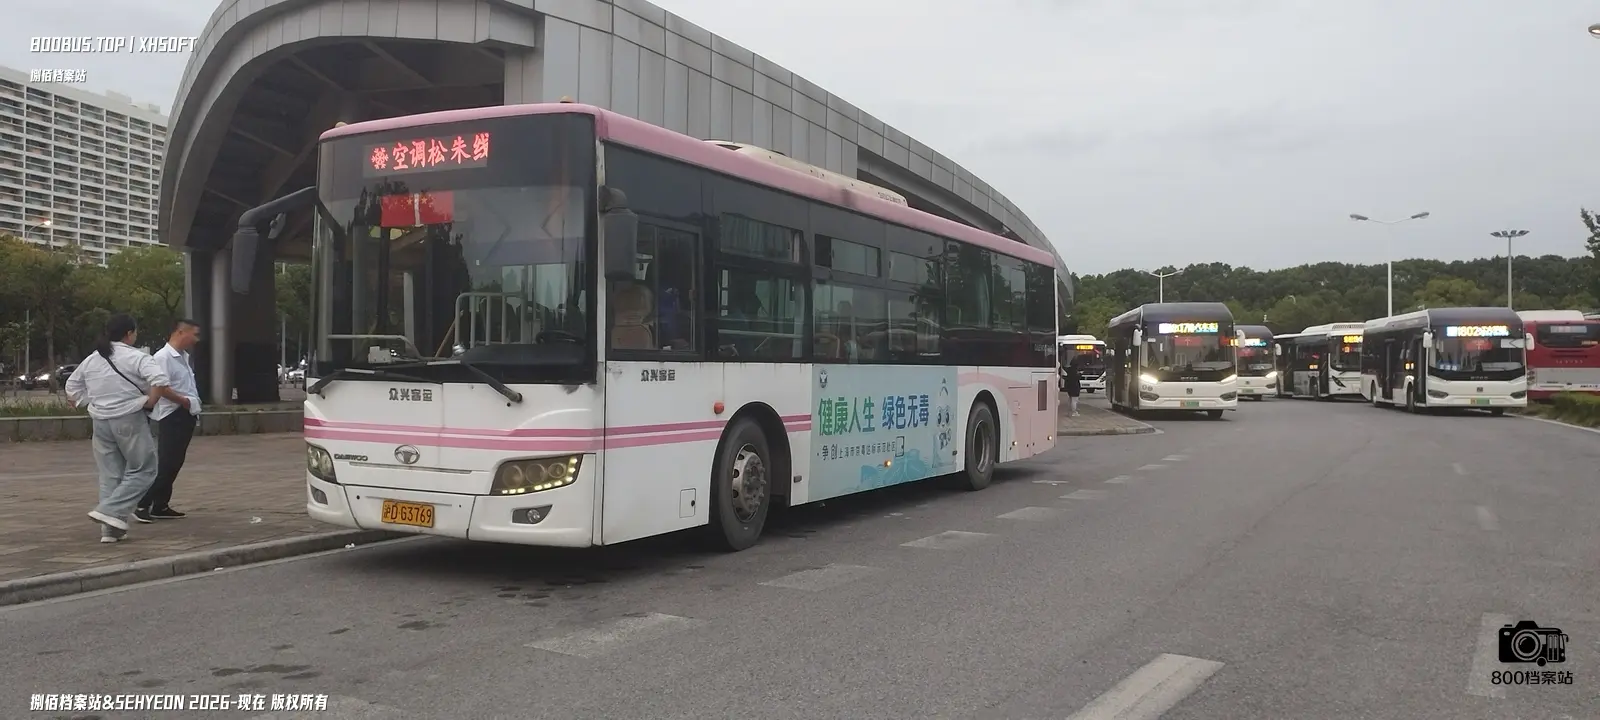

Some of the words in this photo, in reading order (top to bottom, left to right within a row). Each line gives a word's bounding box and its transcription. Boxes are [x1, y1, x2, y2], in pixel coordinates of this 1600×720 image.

[392, 132, 490, 170] 空调松朱线
[388, 387, 433, 402] 众兴客运
[818, 396, 876, 436] 健康人生
[881, 394, 930, 430] 绿色无毒
